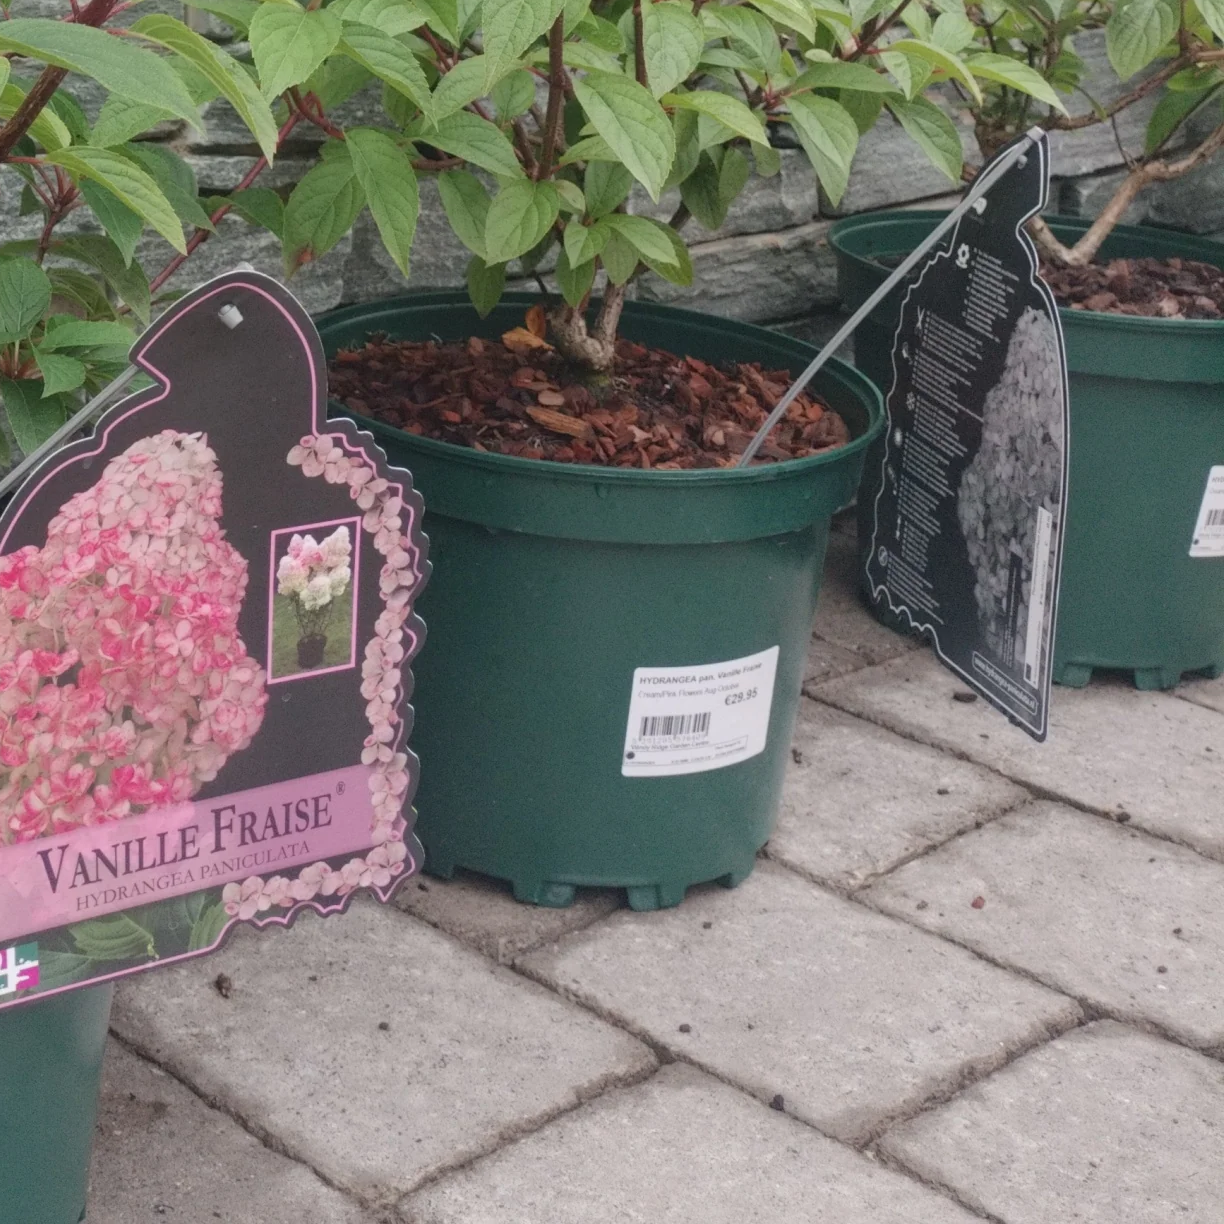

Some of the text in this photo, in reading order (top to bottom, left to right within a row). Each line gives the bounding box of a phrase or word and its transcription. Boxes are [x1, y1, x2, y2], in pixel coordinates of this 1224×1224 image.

[639, 676, 697, 686] HYDRANGEA
[724, 686, 758, 706] €29.95
[37, 825, 201, 894] VANILLE
[75, 841, 311, 913] HYDRANGEA PANICULATA
